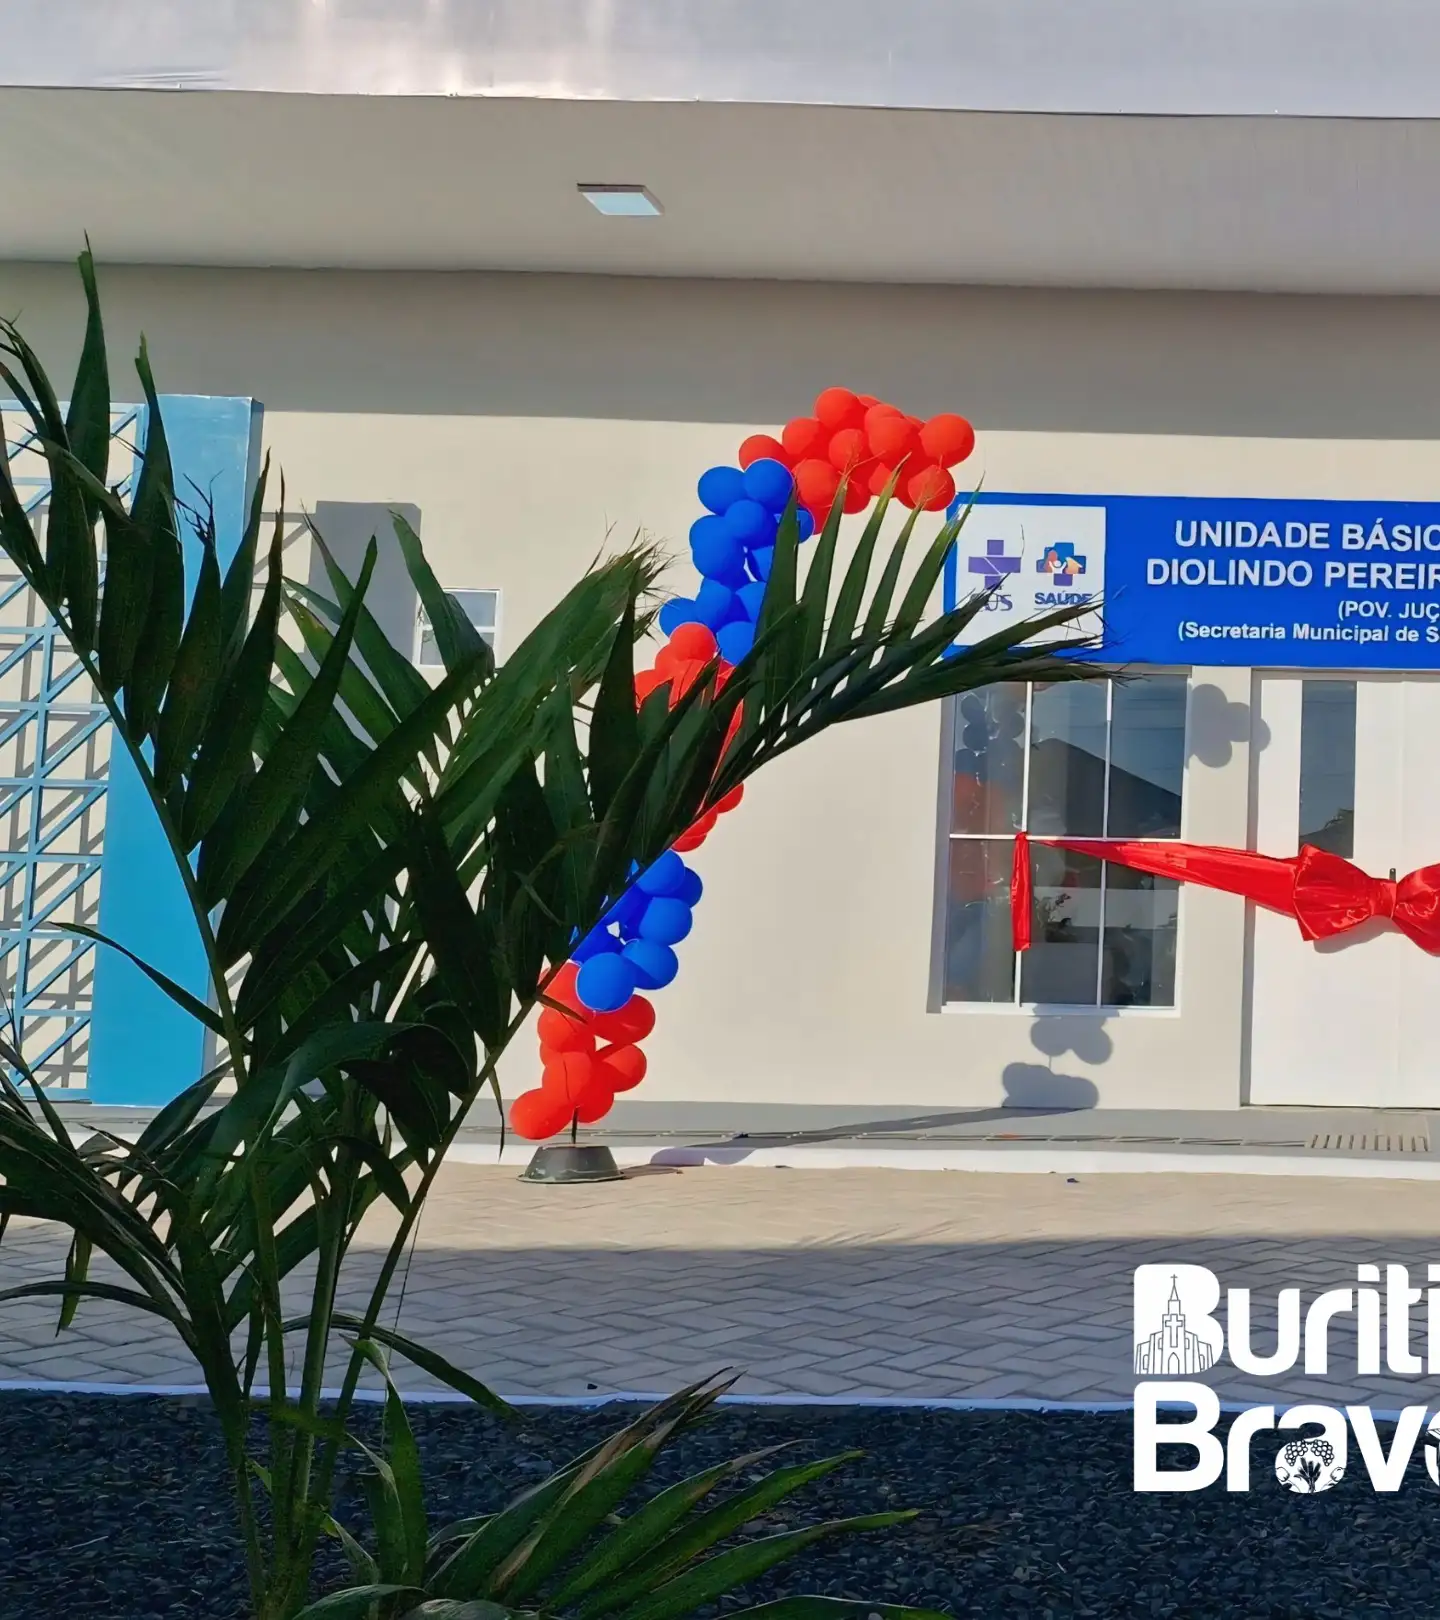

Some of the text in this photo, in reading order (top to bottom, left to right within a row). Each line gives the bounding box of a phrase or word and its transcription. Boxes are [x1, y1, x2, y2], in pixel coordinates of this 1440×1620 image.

[1174, 518, 1330, 550] UNIDADE
[1147, 558, 1313, 587] DIOLINDO
[1338, 600, 1391, 621] (POV.
[1178, 621, 1286, 642] (Secretaria
[1293, 624, 1389, 645] Municipal
[1395, 626, 1420, 642] de
